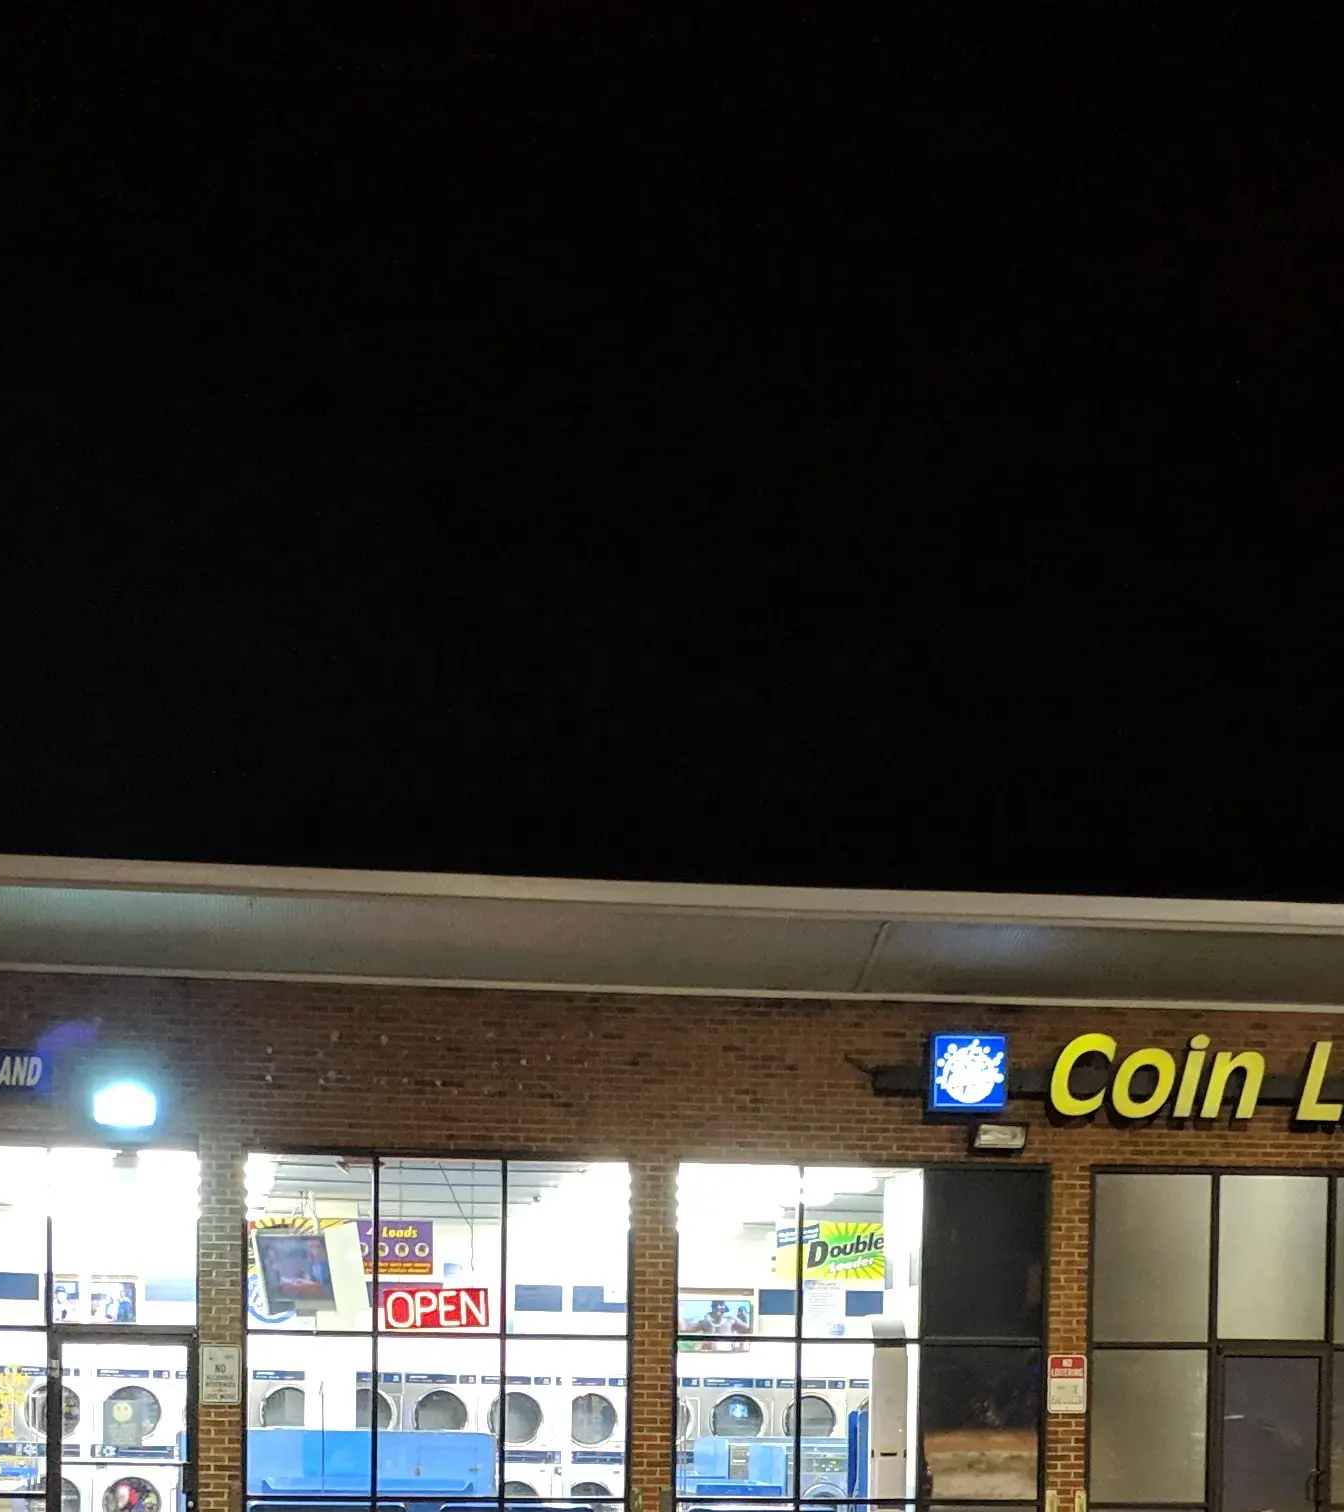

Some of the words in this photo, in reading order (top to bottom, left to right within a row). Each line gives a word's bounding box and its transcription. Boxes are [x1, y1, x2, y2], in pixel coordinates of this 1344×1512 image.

[1049, 1033, 1266, 1122] Coin
[381, 1225, 418, 1238] Loads
[807, 1232, 884, 1268] Double
[386, 1291, 485, 1328] OPEN
[214, 1363, 226, 1374] NO
